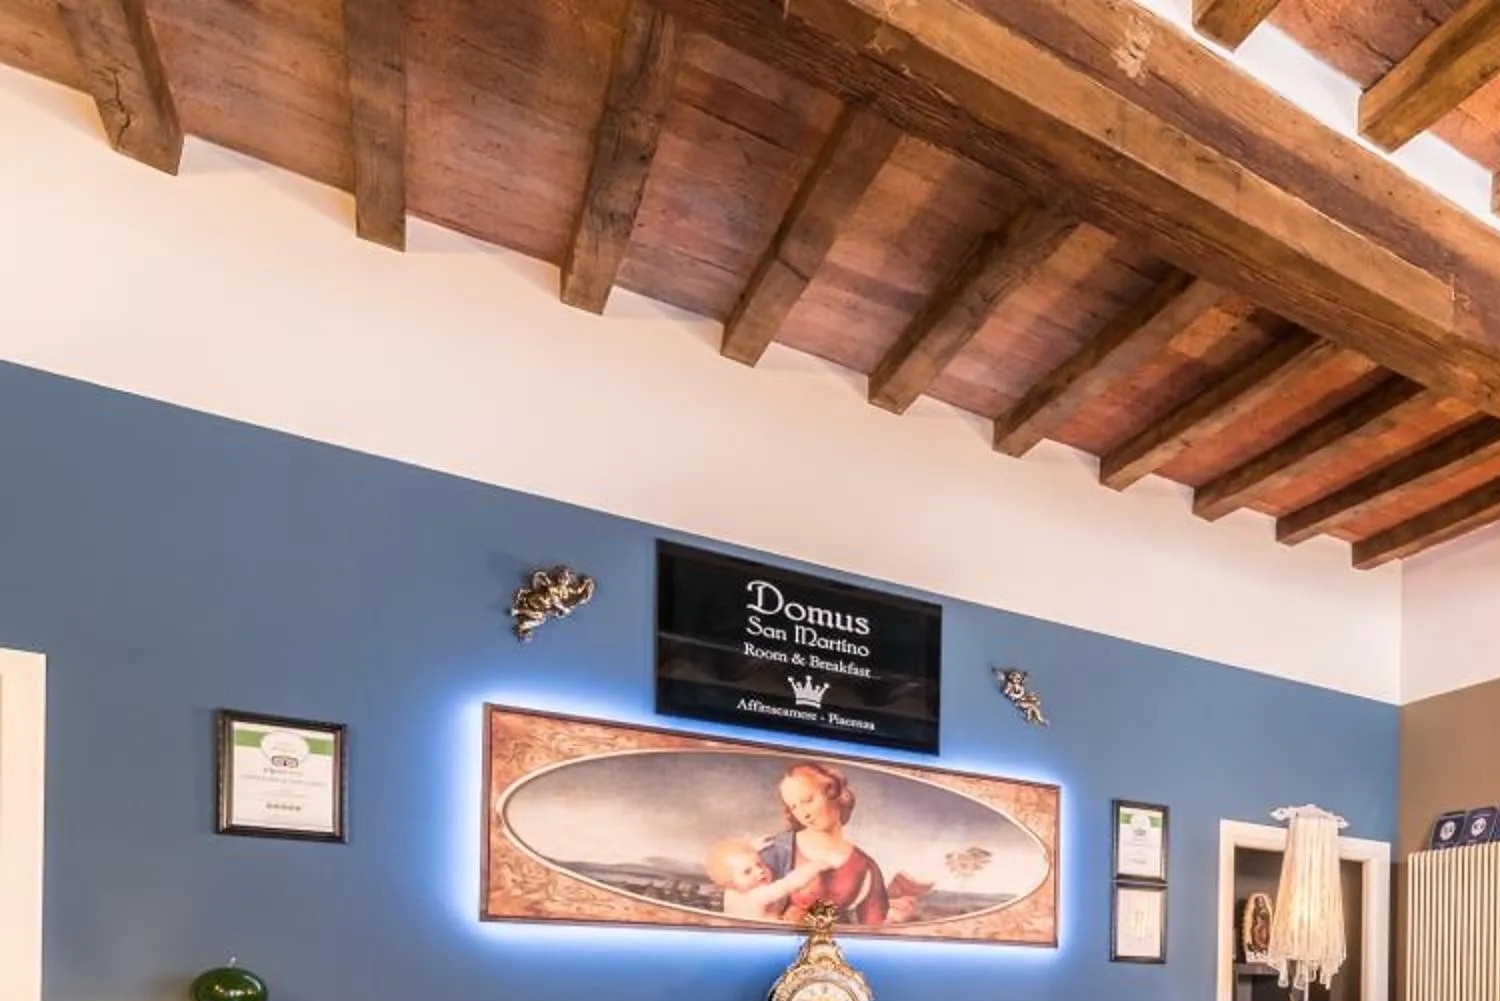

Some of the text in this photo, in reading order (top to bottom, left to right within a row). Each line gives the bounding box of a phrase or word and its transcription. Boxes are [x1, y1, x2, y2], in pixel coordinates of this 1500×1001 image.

[746, 580, 871, 635] Domus
[746, 616, 870, 657] San Martino
[743, 641, 871, 678] Room & Breakfast
